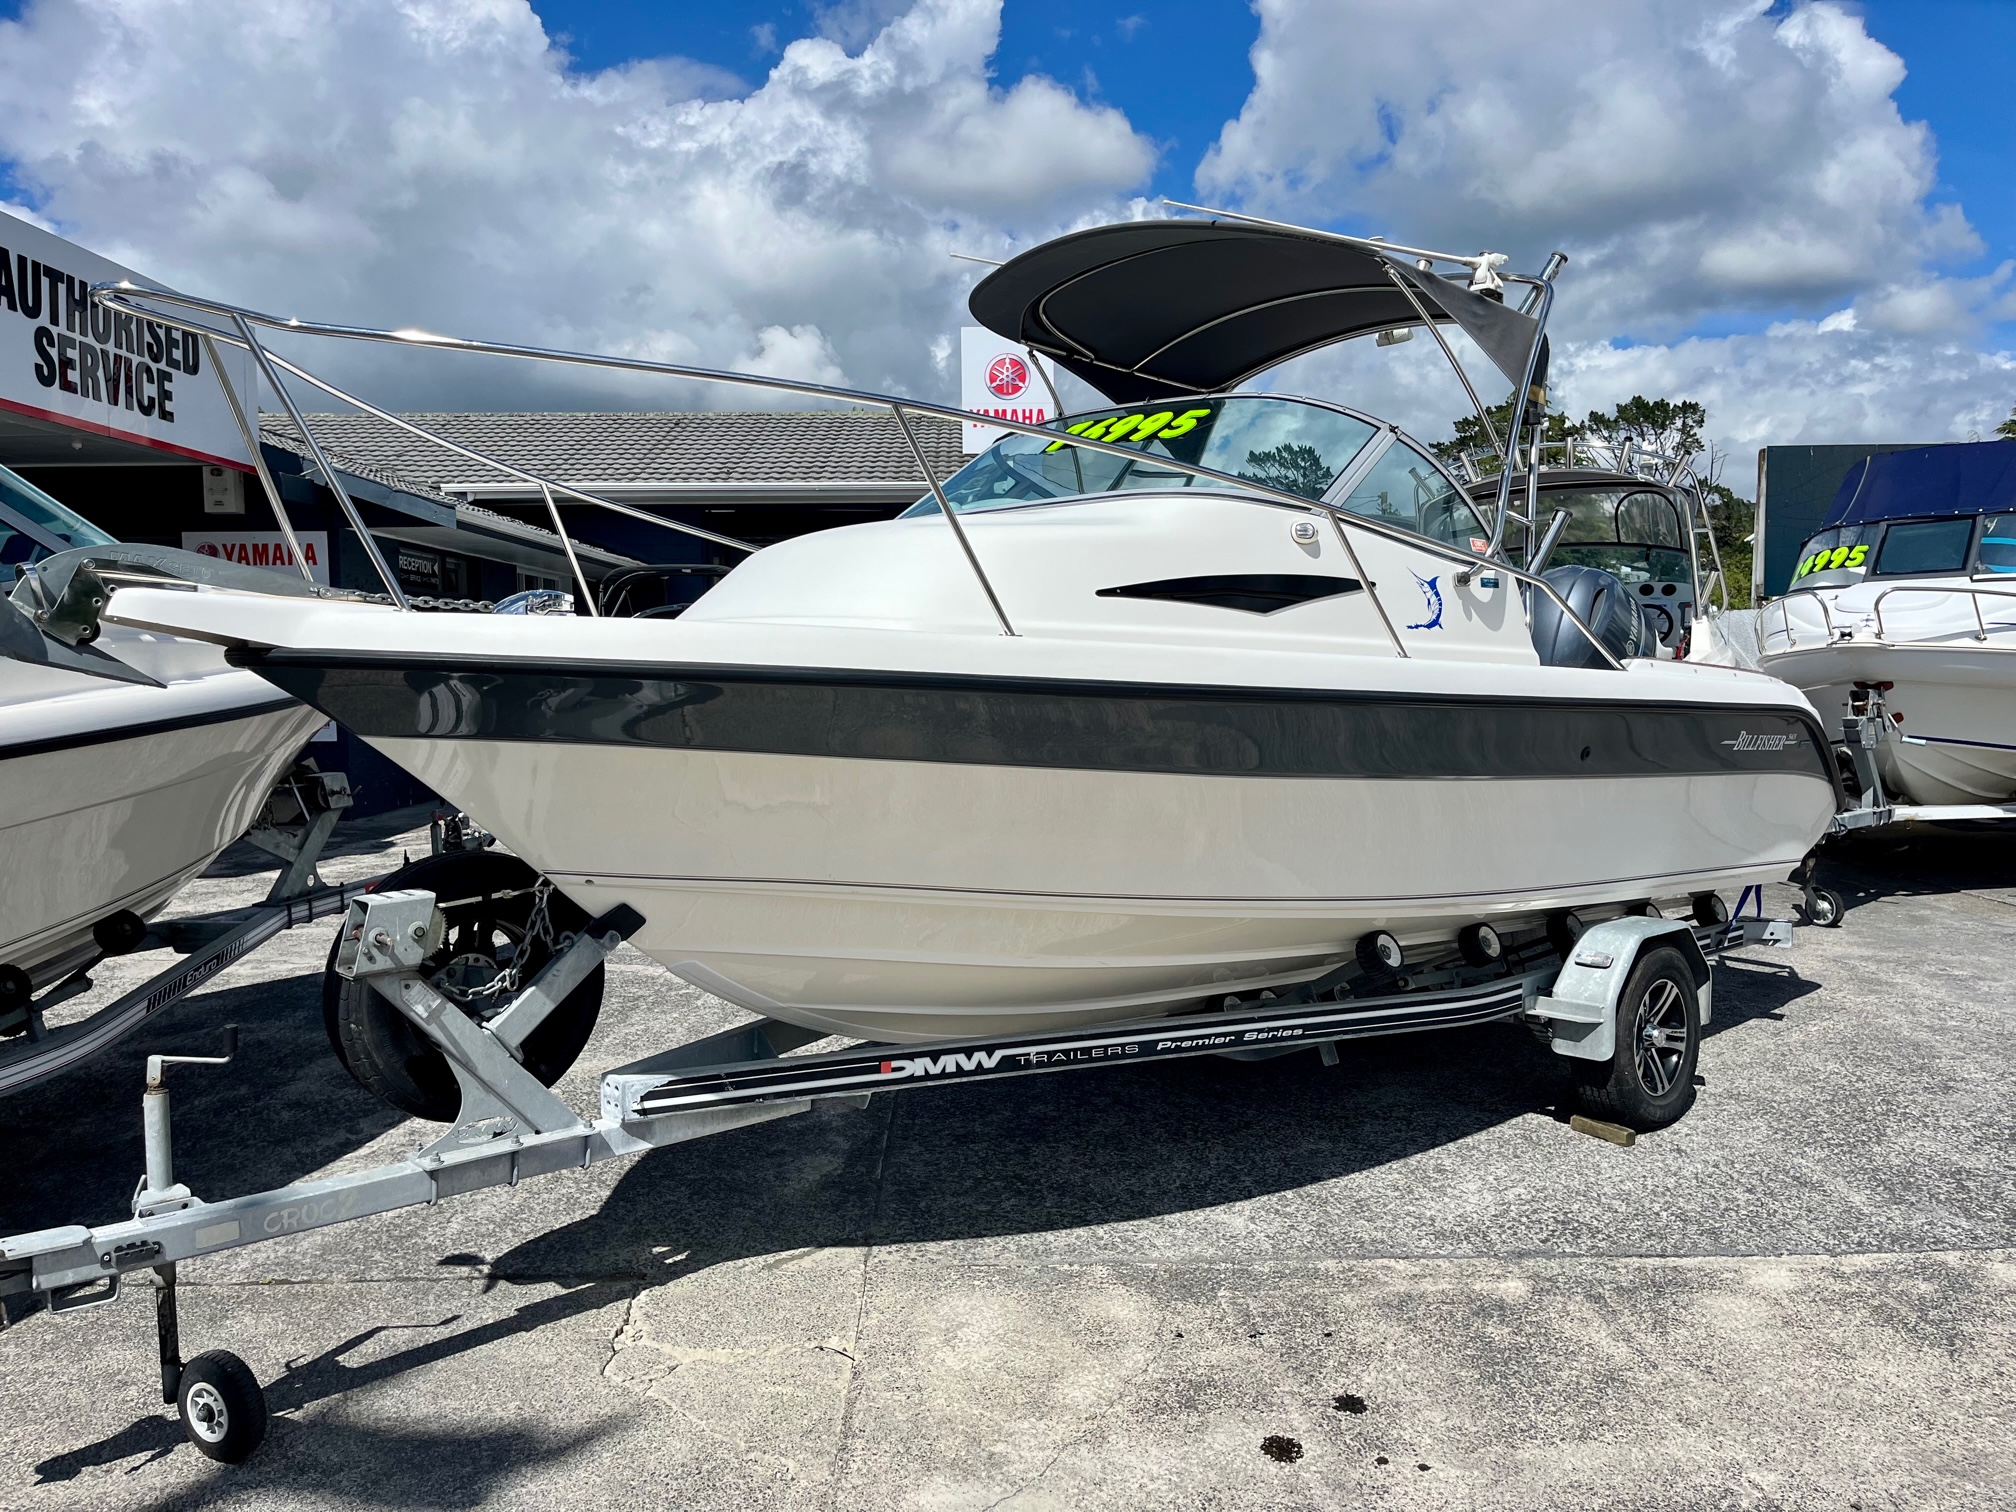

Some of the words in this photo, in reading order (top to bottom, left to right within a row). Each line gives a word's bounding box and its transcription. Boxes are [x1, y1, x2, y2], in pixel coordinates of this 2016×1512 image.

[0, 246, 200, 376] AUTHORISED
[34, 326, 175, 423] SERVICE
[399, 555, 432, 574] RECEPTION
[1733, 730, 1786, 751] BILLFISHER
[186, 959, 218, 986] Enduro
[881, 1050, 1004, 1078] DMW
[1015, 1044, 1139, 1066] TRAILERS
[1156, 1035, 1236, 1051] Premier
[1243, 1028, 1304, 1042] Series
